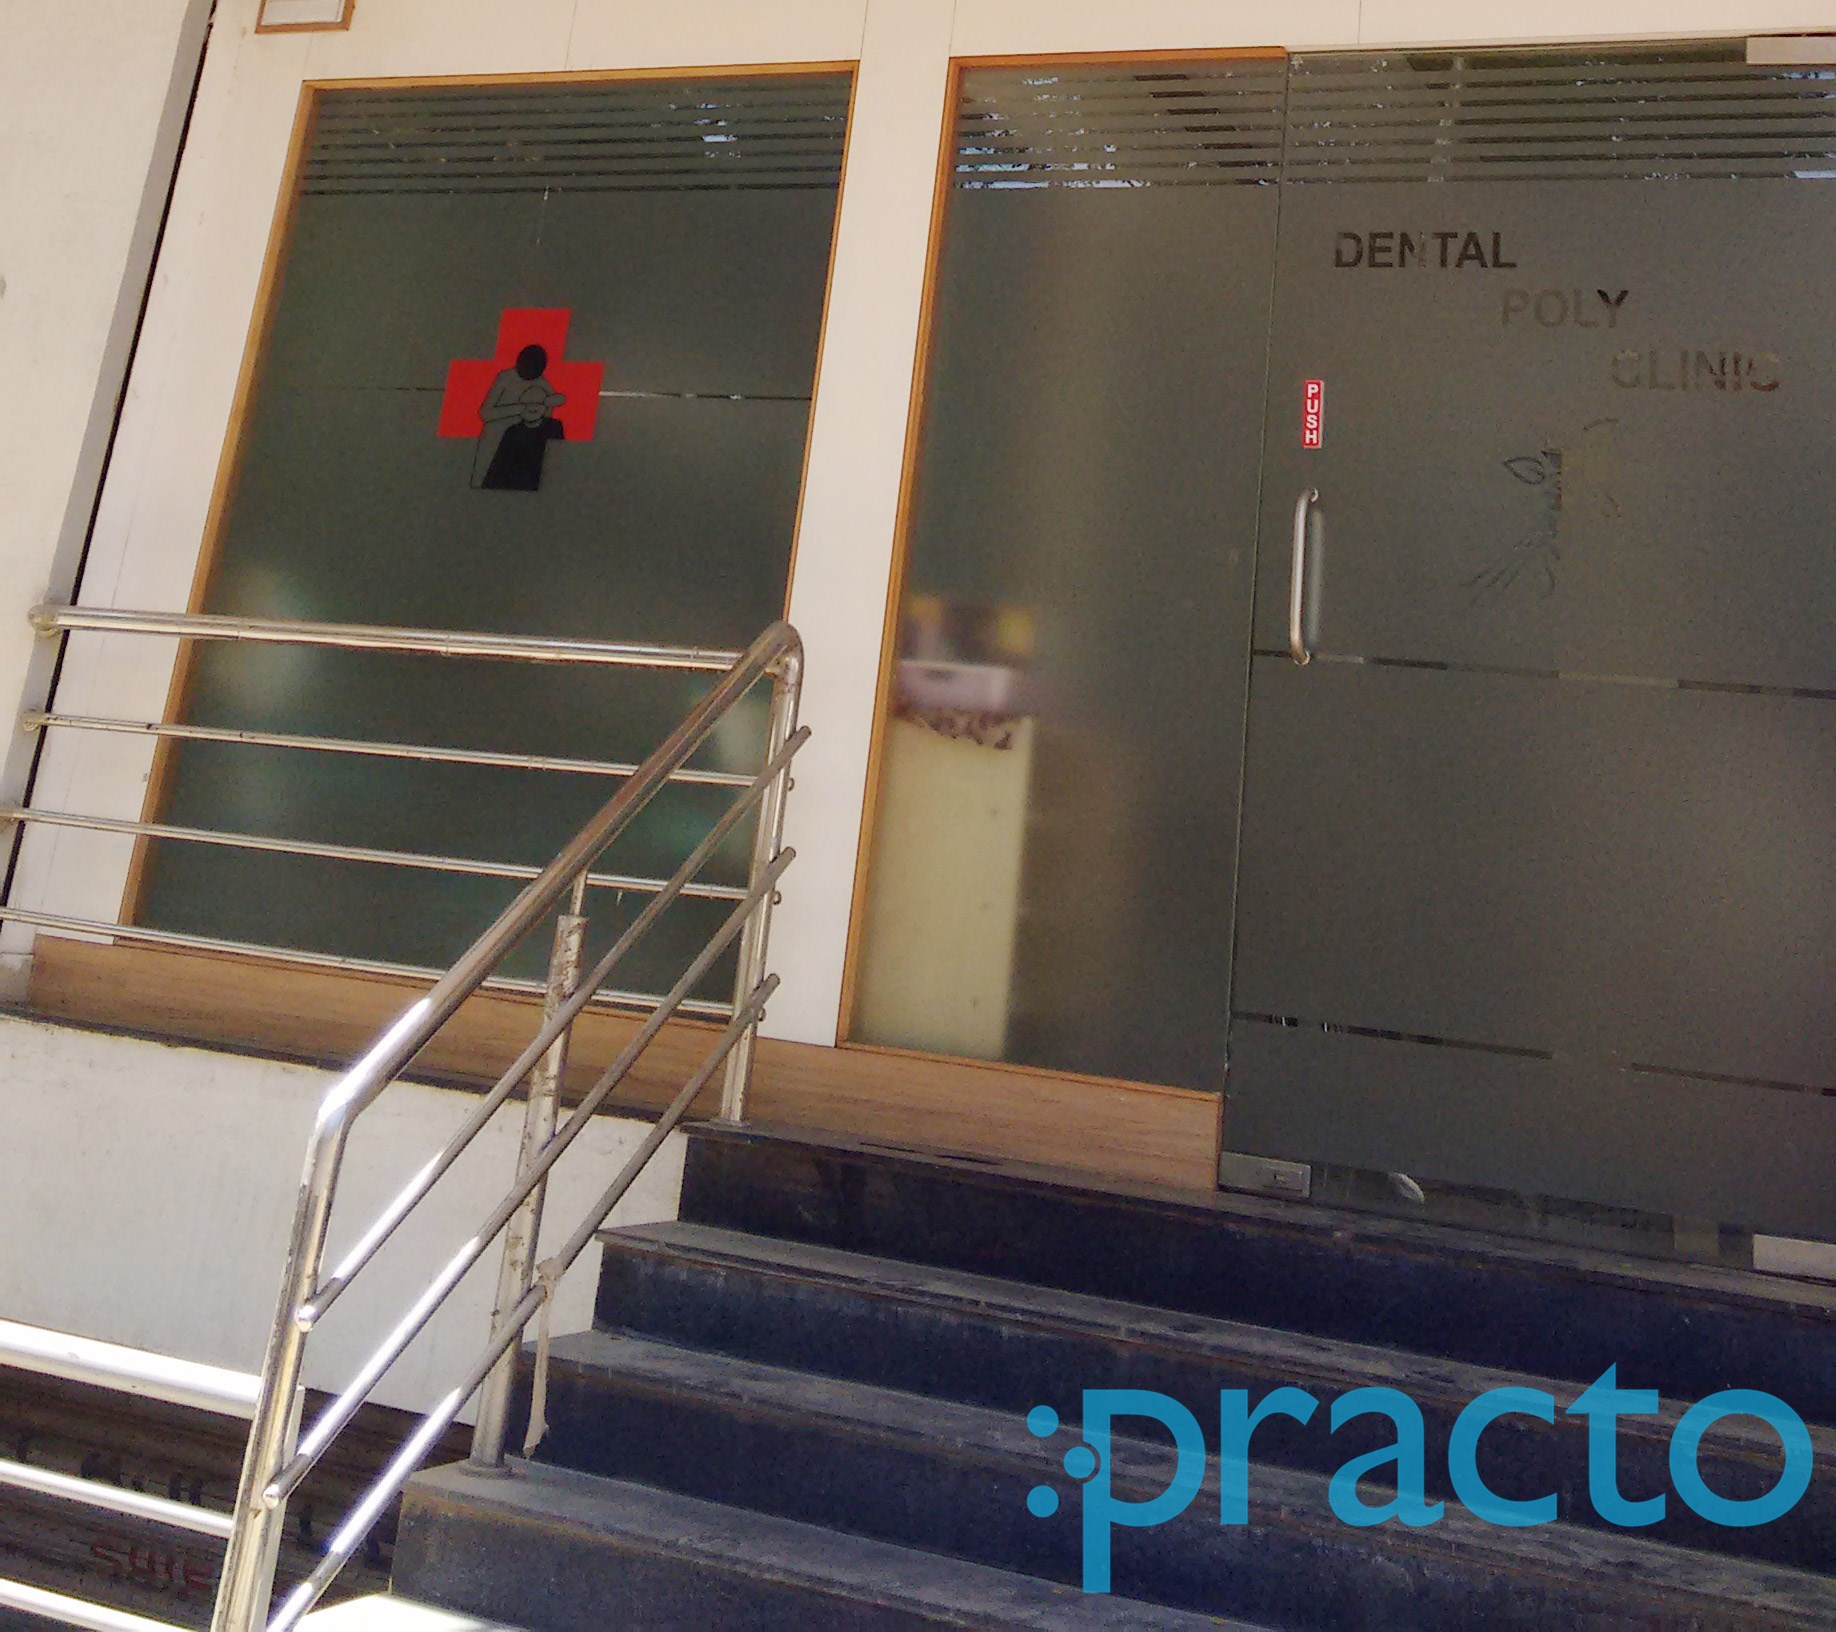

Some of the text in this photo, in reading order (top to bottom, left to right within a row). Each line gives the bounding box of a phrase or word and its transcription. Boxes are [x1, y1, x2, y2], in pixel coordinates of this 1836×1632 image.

[1334, 231, 1517, 269] DENTAL
[1502, 288, 1629, 329] POLY
[1610, 348, 1781, 392] CLINIC
[1305, 383, 1320, 445] PUSH
